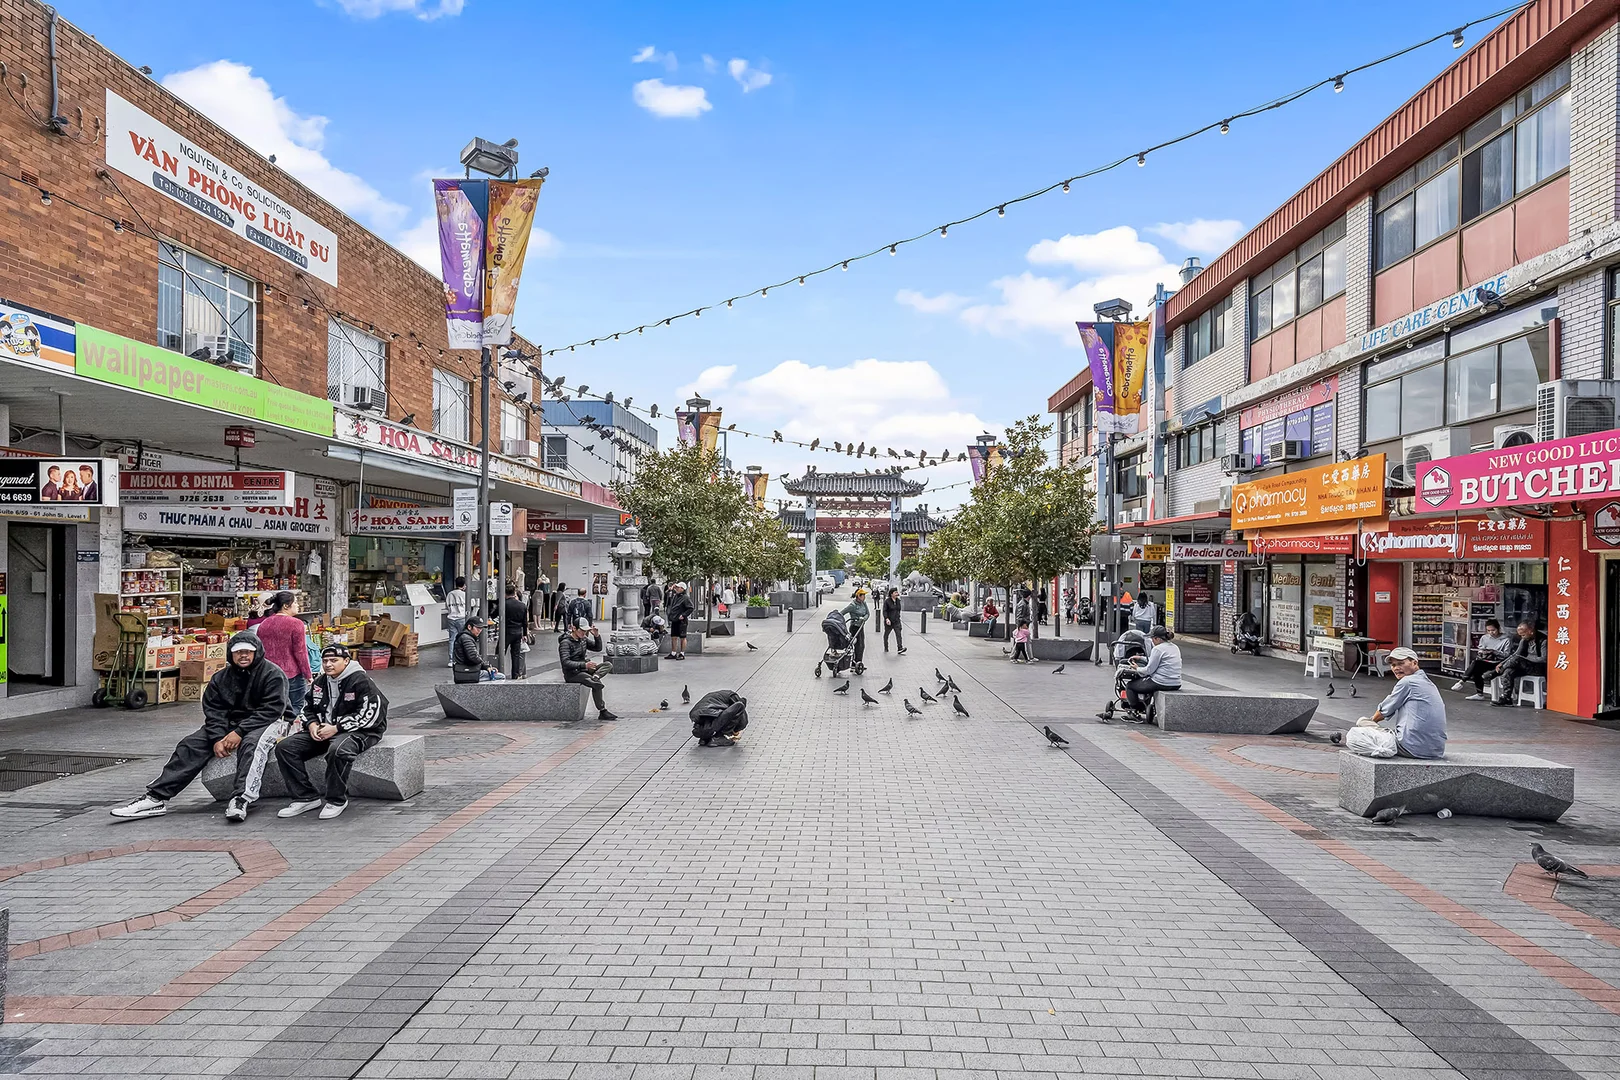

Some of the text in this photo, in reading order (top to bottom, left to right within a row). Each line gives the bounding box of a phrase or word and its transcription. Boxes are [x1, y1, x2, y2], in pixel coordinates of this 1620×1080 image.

[159, 178, 174, 193] Tel:
[180, 142, 292, 220] NGUYEN & Co SOLICITORS
[129, 130, 330, 263] VĂN PHÒNG LUẬT SƯ
[1361, 274, 1508, 352] LIFE CARE CENTRE
[81, 339, 205, 394] wallpaper
[1121, 347, 1137, 399] Cabramatta
[212, 399, 229, 411] MADE
[238, 404, 257, 417] KOREA
[1257, 393, 1310, 418] PHYSIOTHERAPY
[379, 425, 422, 455] HOA
[1488, 437, 1620, 470] NEW GOOD LUC
[130, 475, 280, 488] MEDICAL & DENTAL CENTRE
[0, 493, 32, 502] 64 6639
[1249, 487, 1307, 513] pharmacy
[313, 498, 328, 520] 生
[139, 511, 148, 521] 63
[263, 519, 288, 531] ASIAN
[290, 521, 320, 533] GROCERY
[406, 516, 450, 525] SANH
[542, 520, 568, 531] Plus
[1184, 547, 1224, 558] Medical
[1267, 538, 1320, 550] pharmacy
[1379, 532, 1458, 553] pharmacy
[1555, 556, 1573, 671] 仁愛西藥房
